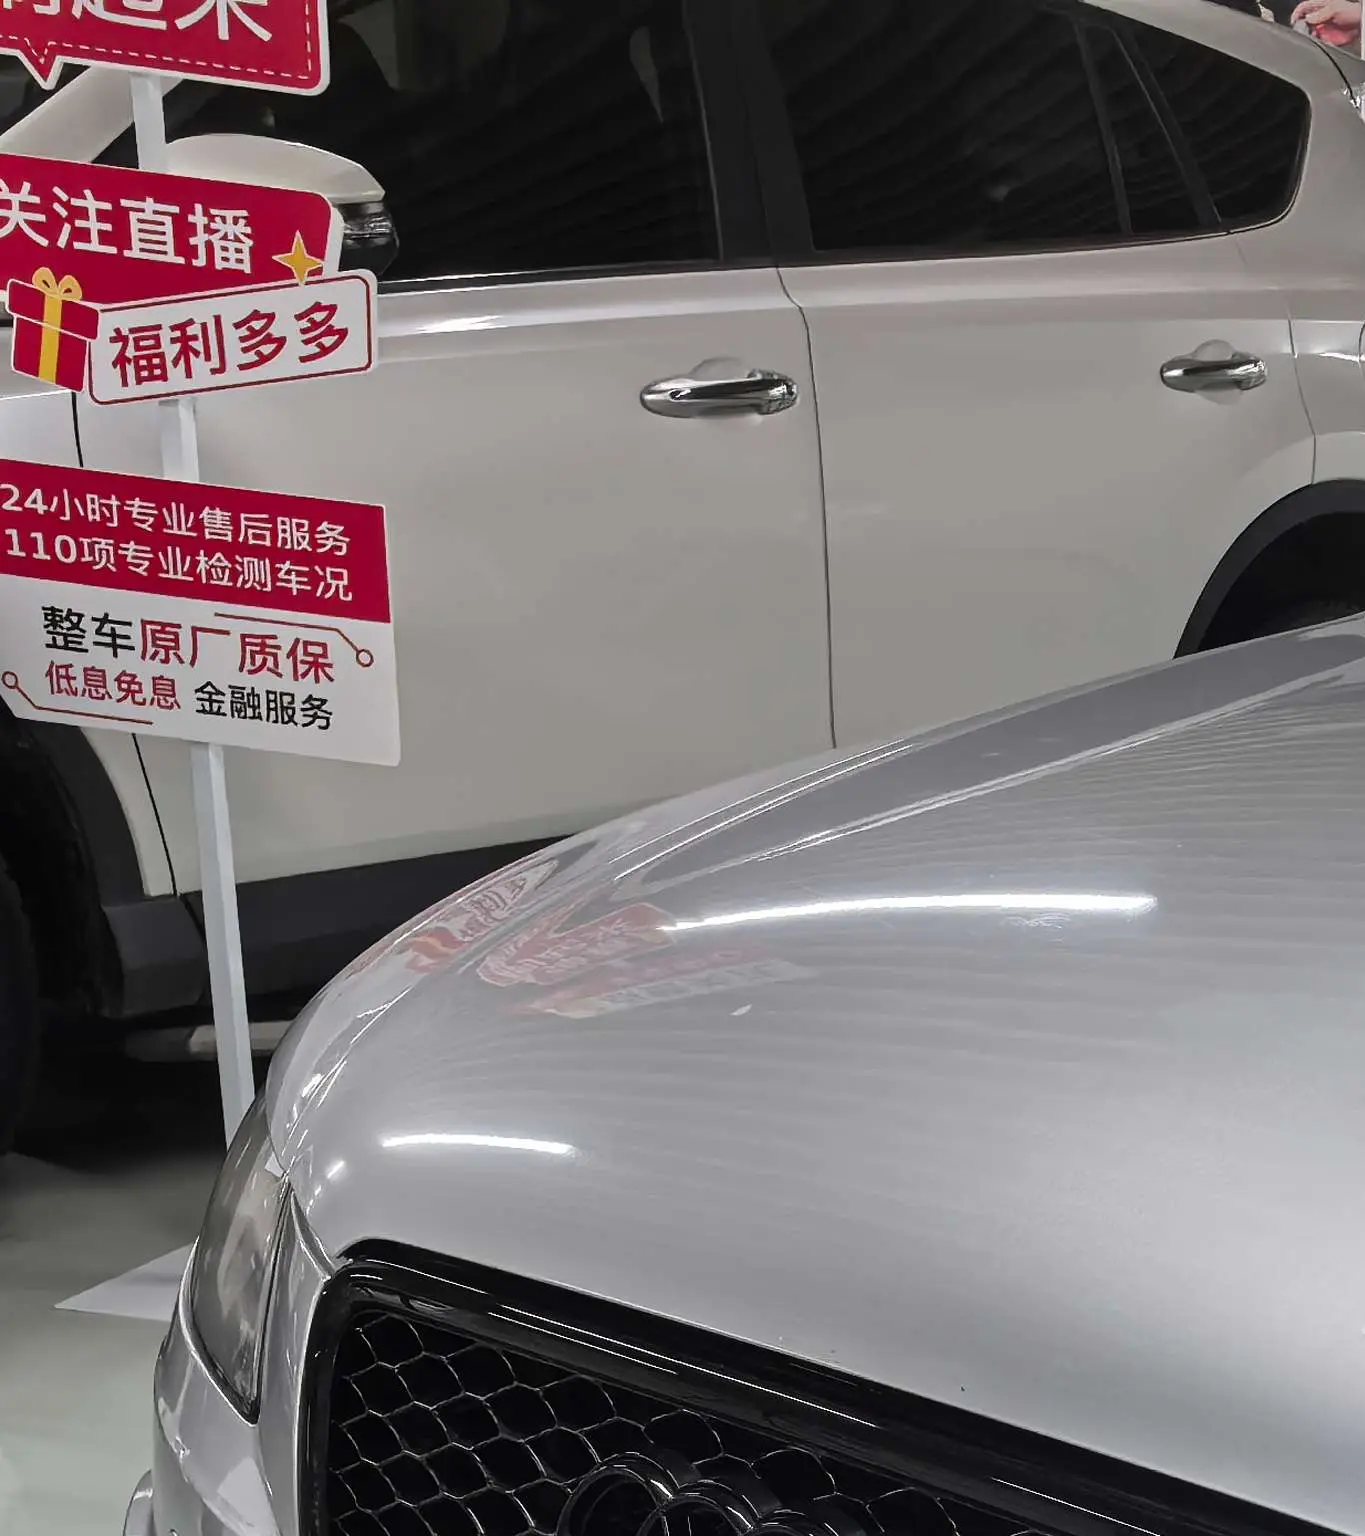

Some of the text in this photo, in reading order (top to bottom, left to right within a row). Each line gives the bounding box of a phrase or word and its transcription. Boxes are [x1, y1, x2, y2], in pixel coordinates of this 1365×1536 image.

[0, 180, 254, 275] 关注直播
[109, 300, 350, 388] 福利多多
[0, 483, 351, 556] 24小时专业售后服务
[5, 528, 353, 602] 110项专业检测车况
[41, 605, 336, 685] 整车原厂质保
[45, 660, 334, 731] 低息免息 金融服务
